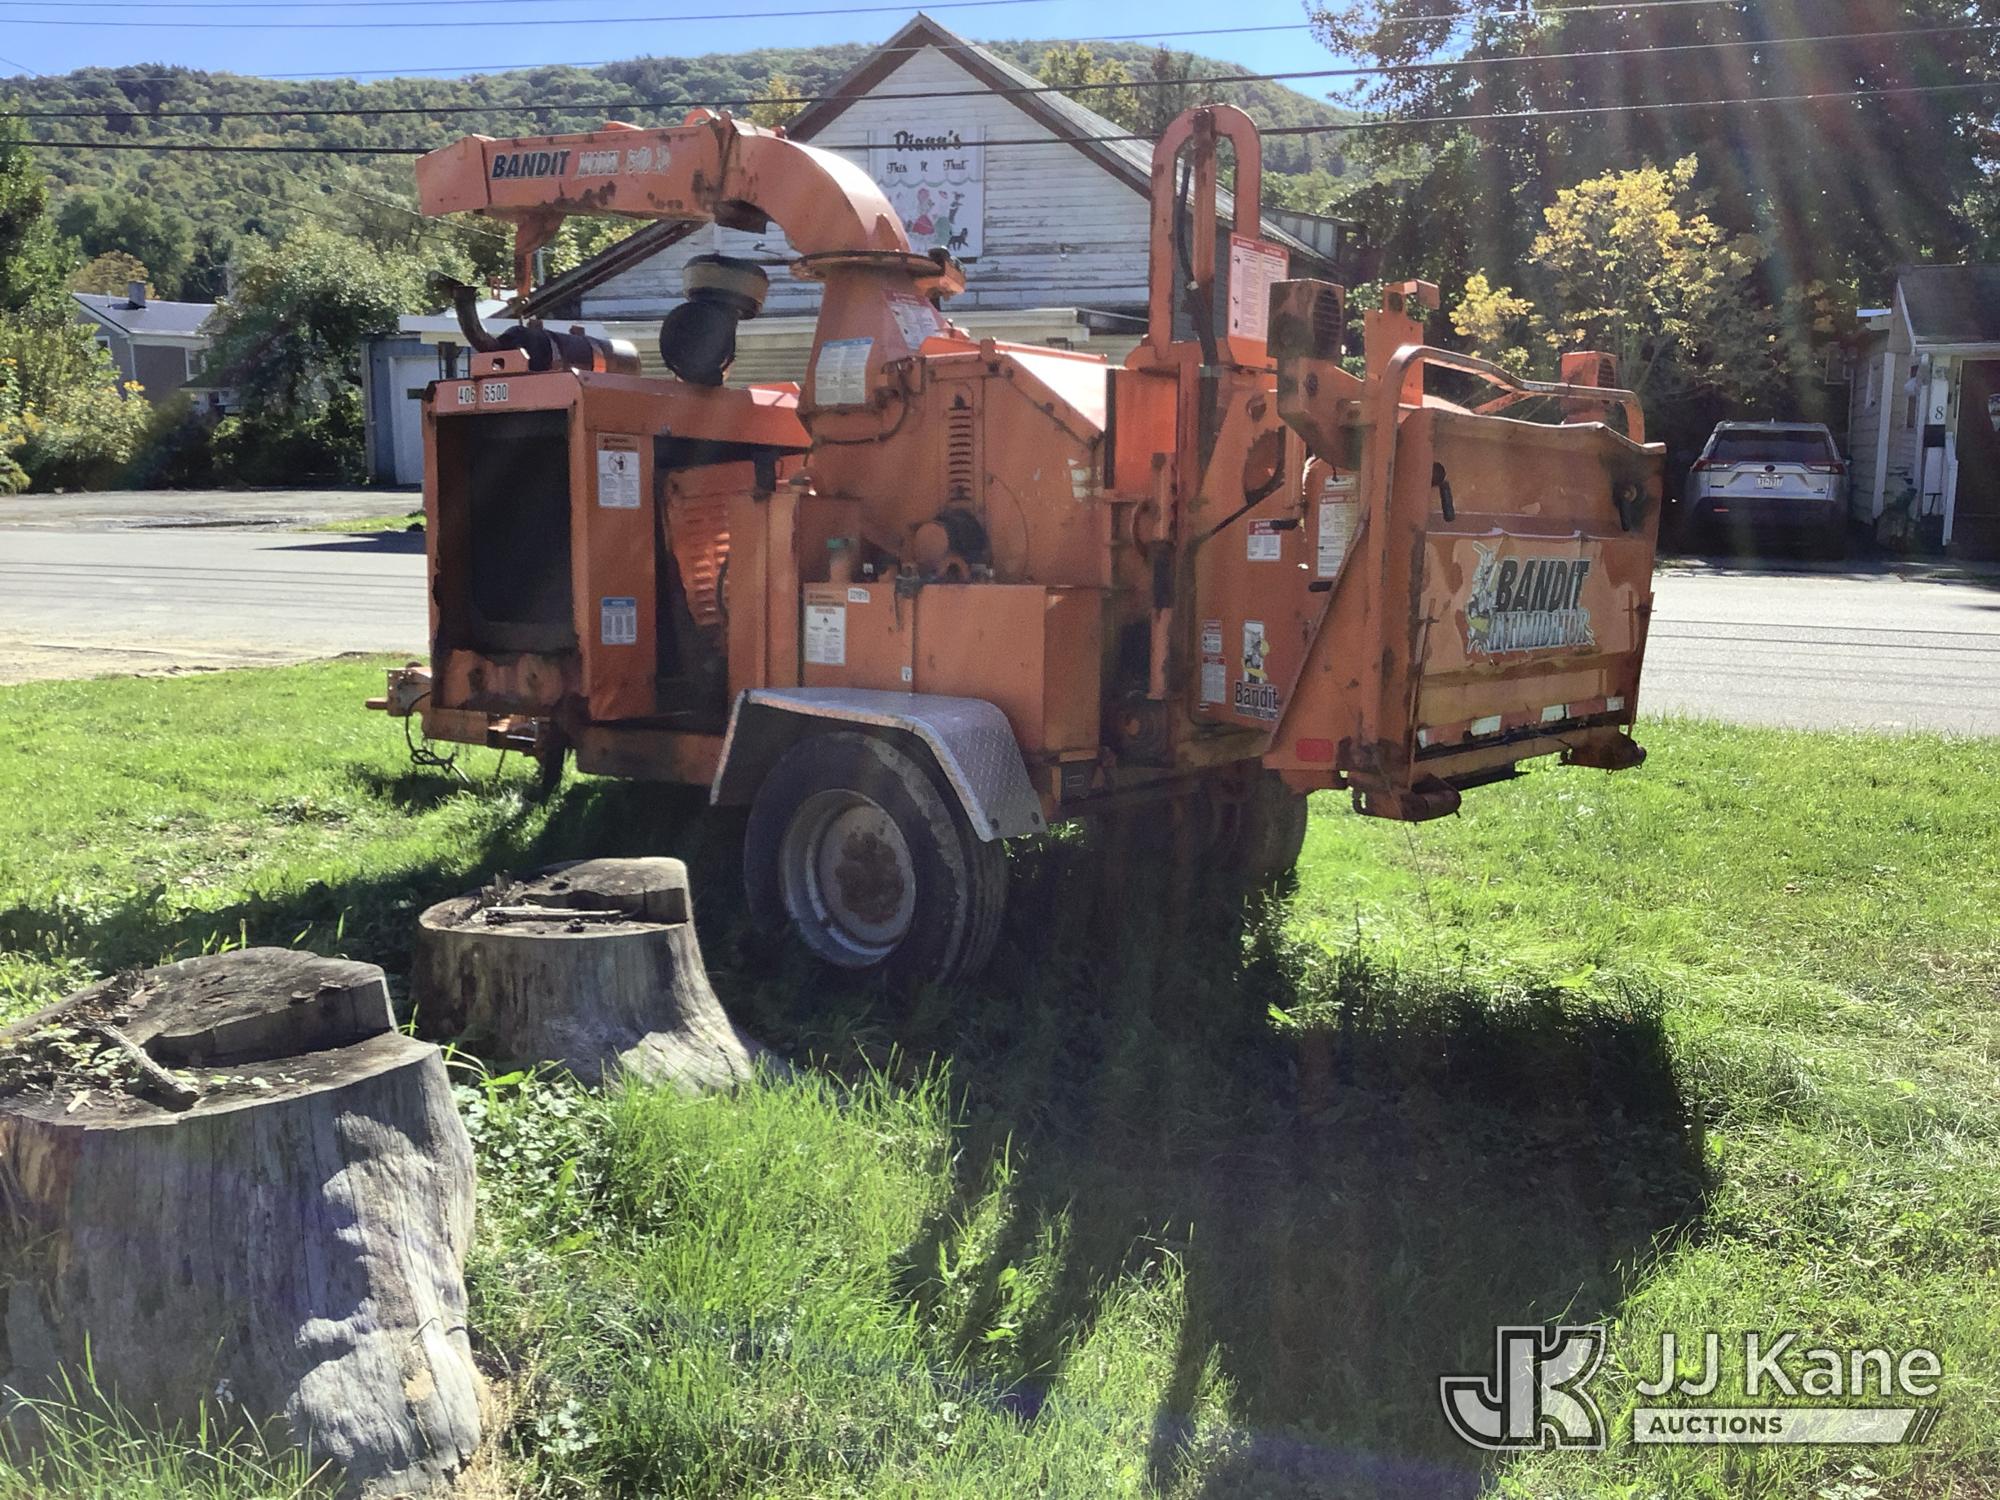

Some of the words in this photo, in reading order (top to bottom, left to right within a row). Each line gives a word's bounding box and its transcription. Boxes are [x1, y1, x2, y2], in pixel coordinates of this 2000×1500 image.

[491, 150, 570, 178] BANDIT
[886, 162, 908, 174] This
[943, 159, 969, 171] That
[1935, 405, 1944, 420] 8
[1495, 558, 1591, 613] BANDIT
[1487, 608, 1590, 653] INTIMIDATOR
[1234, 681, 1279, 711] Bandit
